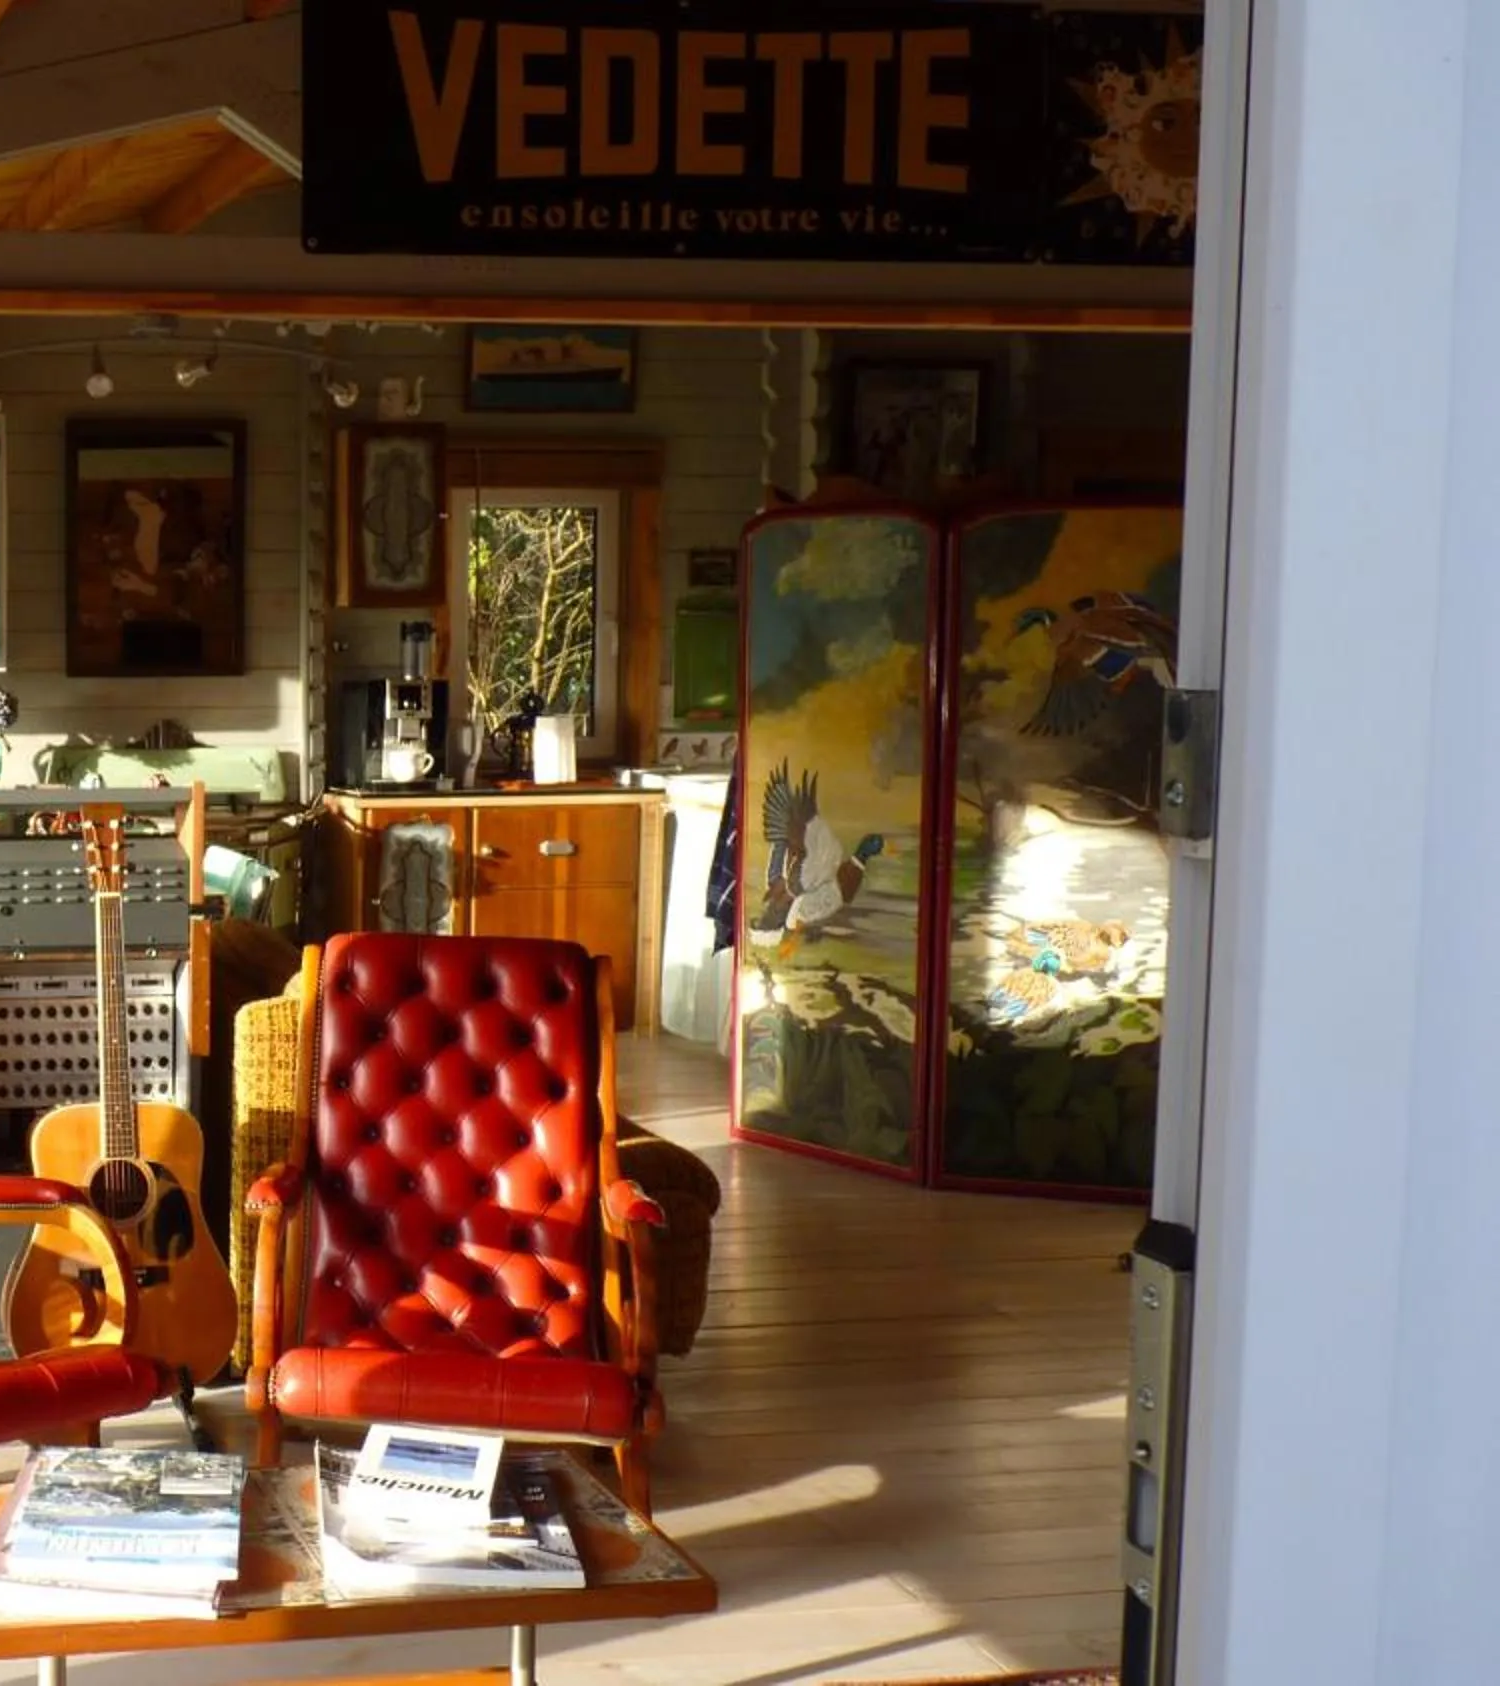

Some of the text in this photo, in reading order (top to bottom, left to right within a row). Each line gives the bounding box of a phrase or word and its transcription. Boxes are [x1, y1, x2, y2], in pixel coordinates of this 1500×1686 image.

[387, 8, 971, 193] VEDETTE
[460, 198, 698, 231] ensoleille
[715, 202, 820, 234] votre
[356, 1474, 485, 1501] Manche
